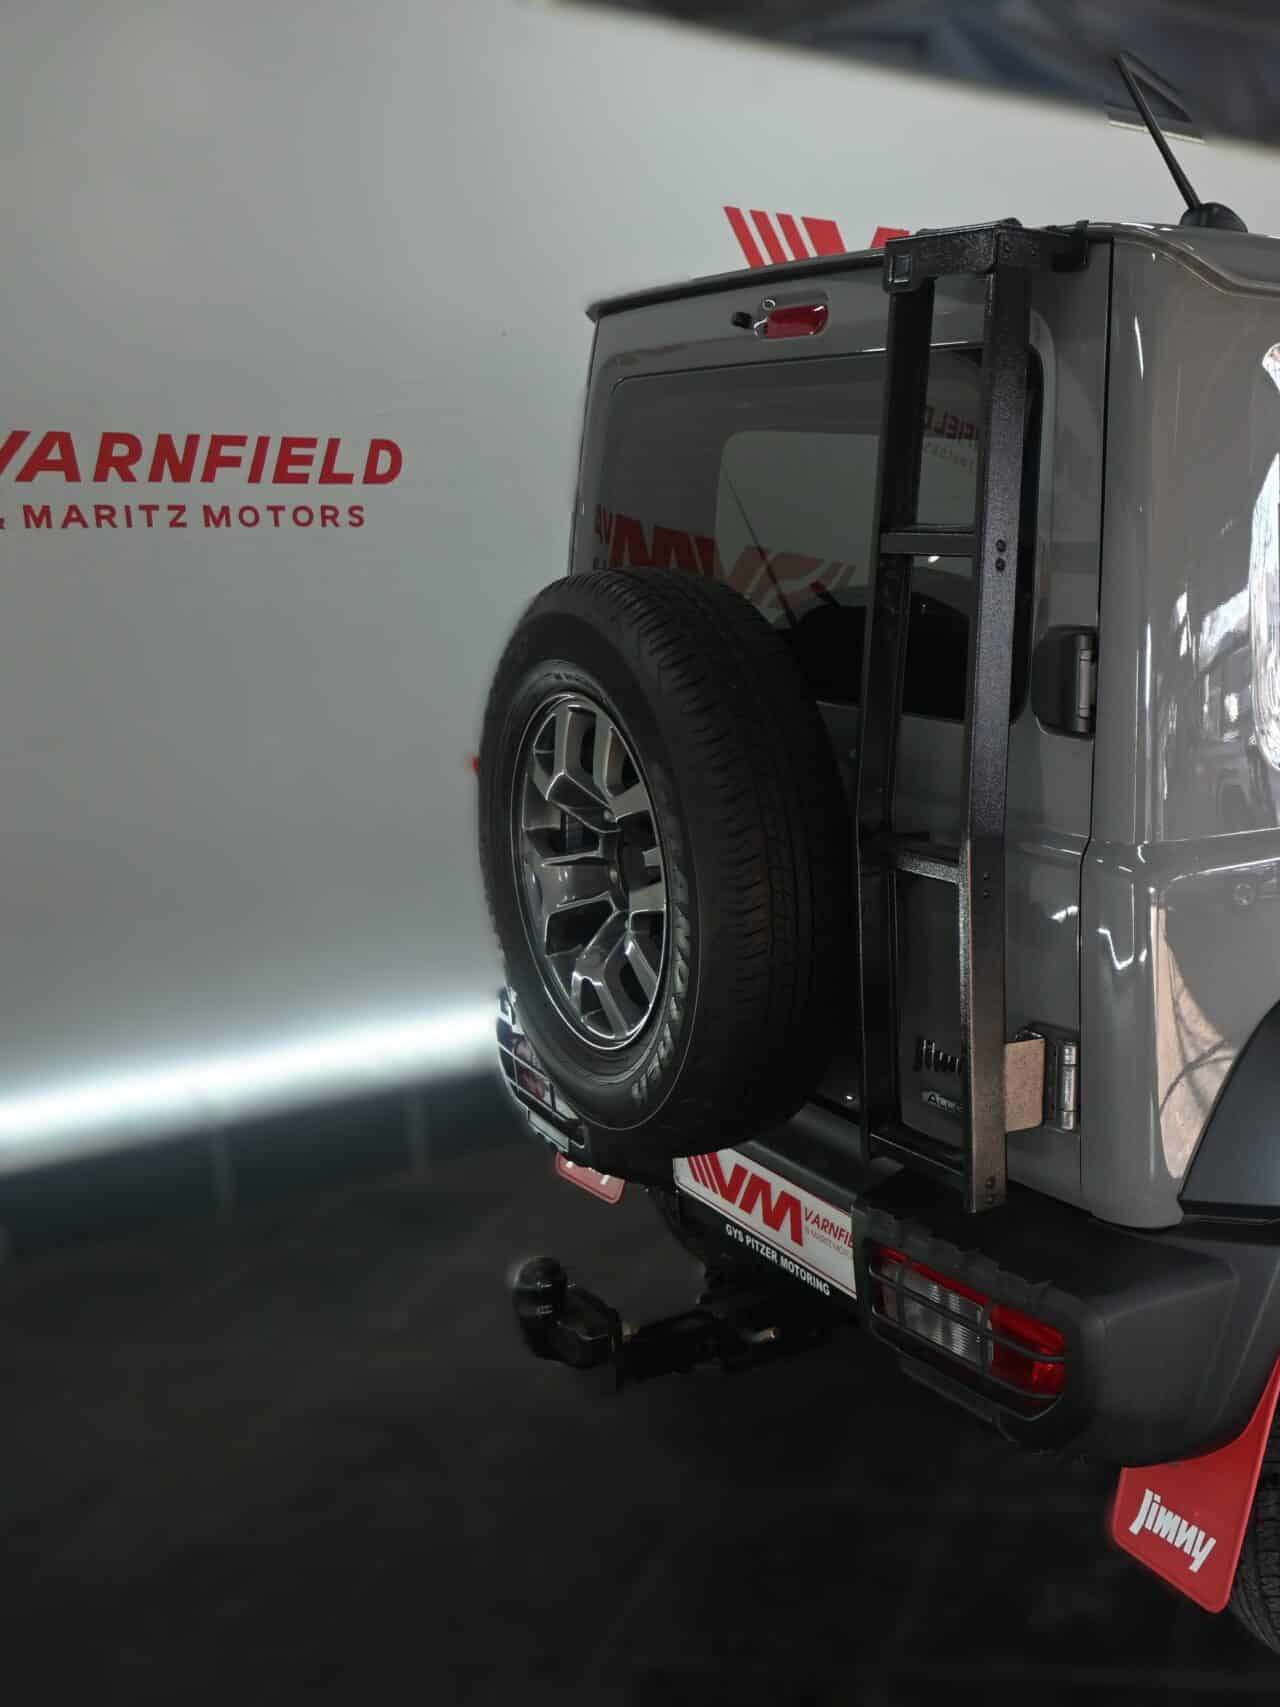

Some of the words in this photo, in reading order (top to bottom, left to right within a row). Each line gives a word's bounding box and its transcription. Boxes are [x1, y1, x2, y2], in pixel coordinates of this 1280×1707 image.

[22, 504, 187, 528] MARITZ
[203, 505, 365, 528] MOTORS
[780, 1255, 831, 1296] MOTORING
